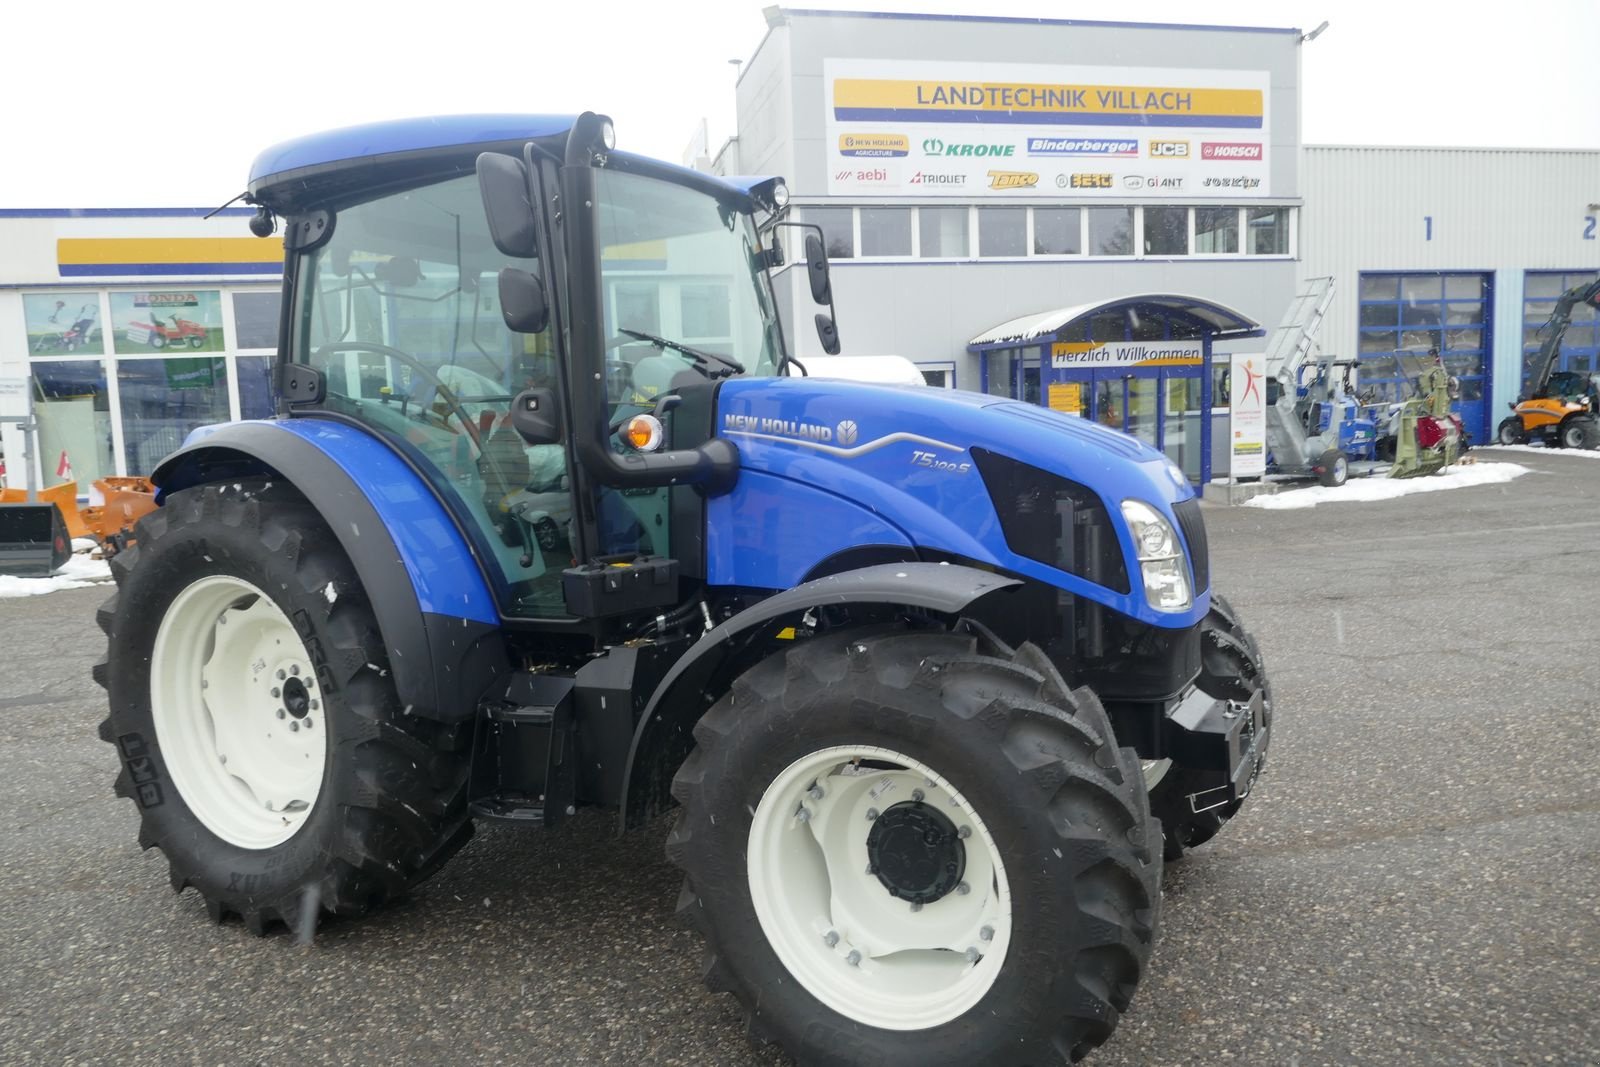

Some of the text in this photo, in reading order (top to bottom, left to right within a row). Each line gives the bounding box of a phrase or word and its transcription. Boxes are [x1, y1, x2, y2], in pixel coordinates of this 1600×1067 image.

[917, 85, 1192, 111] LANDTECHNIK VILLACH
[872, 139, 904, 147] HOLLAND
[945, 144, 1016, 157] KRONE
[1030, 139, 1137, 153] Binderberger
[1151, 142, 1188, 155] JCB
[1213, 145, 1260, 157] HORSCH
[857, 168, 888, 181] aebi
[987, 170, 1040, 190] Tanco
[1424, 216, 1433, 241] 1
[1583, 215, 1598, 240] 2
[133, 293, 199, 303] HONDA
[1055, 346, 1201, 363] Herzlich Willkommen
[725, 413, 833, 442] NEW HOLLAND
[119, 732, 166, 809] BKT
